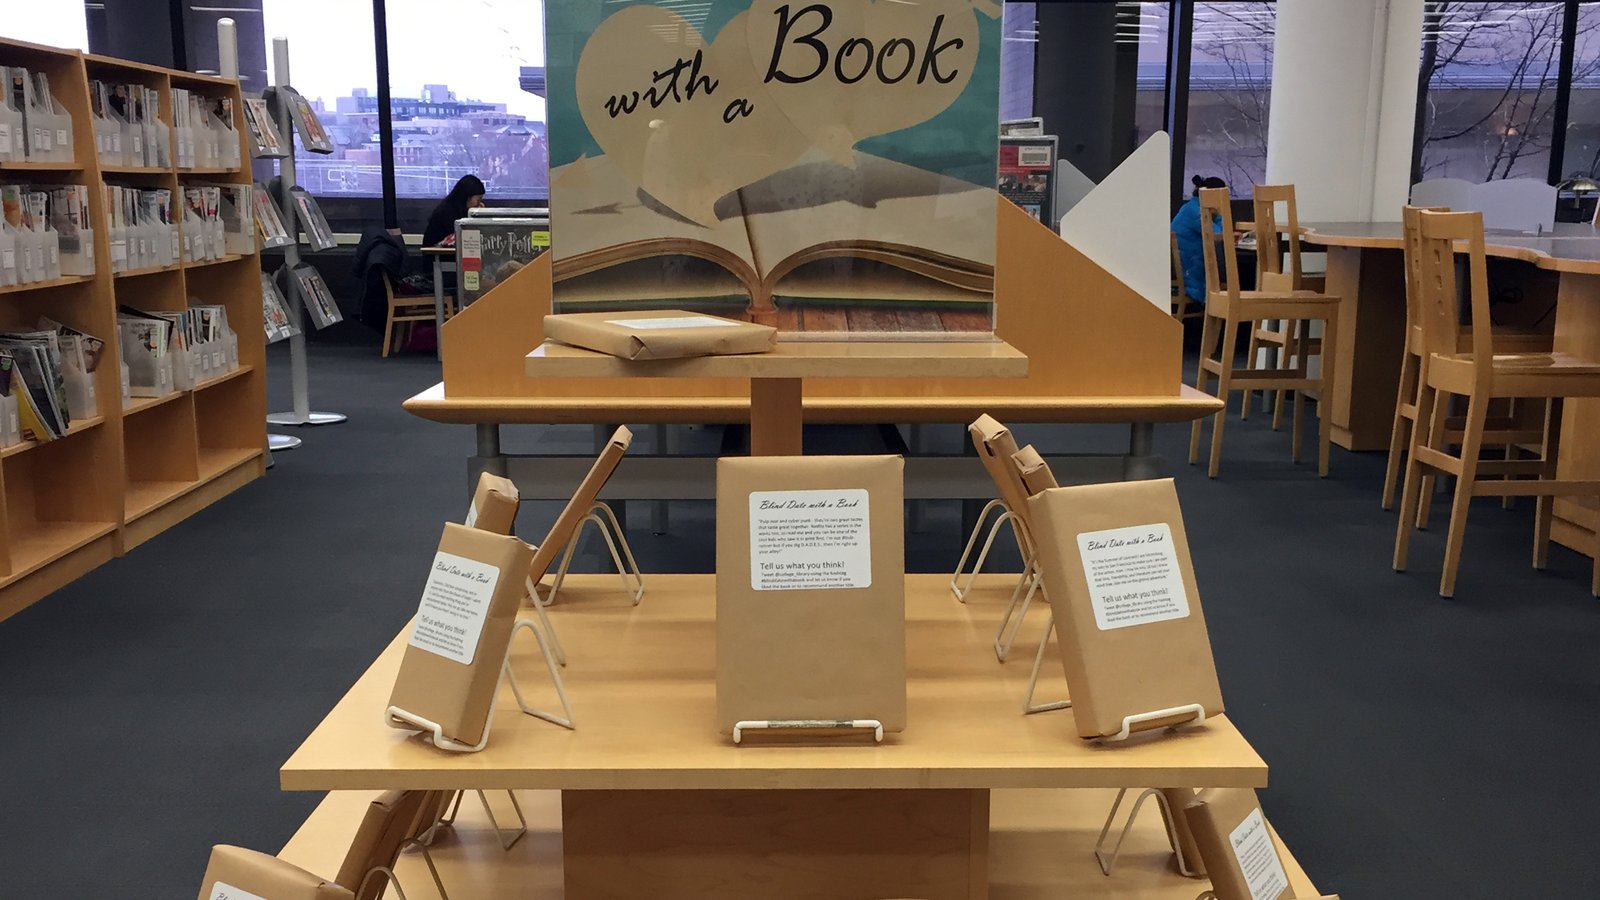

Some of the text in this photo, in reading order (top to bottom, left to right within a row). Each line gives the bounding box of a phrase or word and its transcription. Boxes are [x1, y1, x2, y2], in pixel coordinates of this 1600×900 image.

[604, 4, 964, 123] with a Book
[759, 500, 786, 510] Blind
[787, 500, 807, 509] Date
[808, 500, 827, 509] with
[836, 498, 859, 508] Book
[1088, 540, 1107, 551] Blind
[1147, 534, 1164, 543] Book
[760, 562, 774, 570] Tell
[1102, 595, 1114, 603] Tell
[1123, 592, 1138, 600] what
[1140, 592, 1150, 600] you
